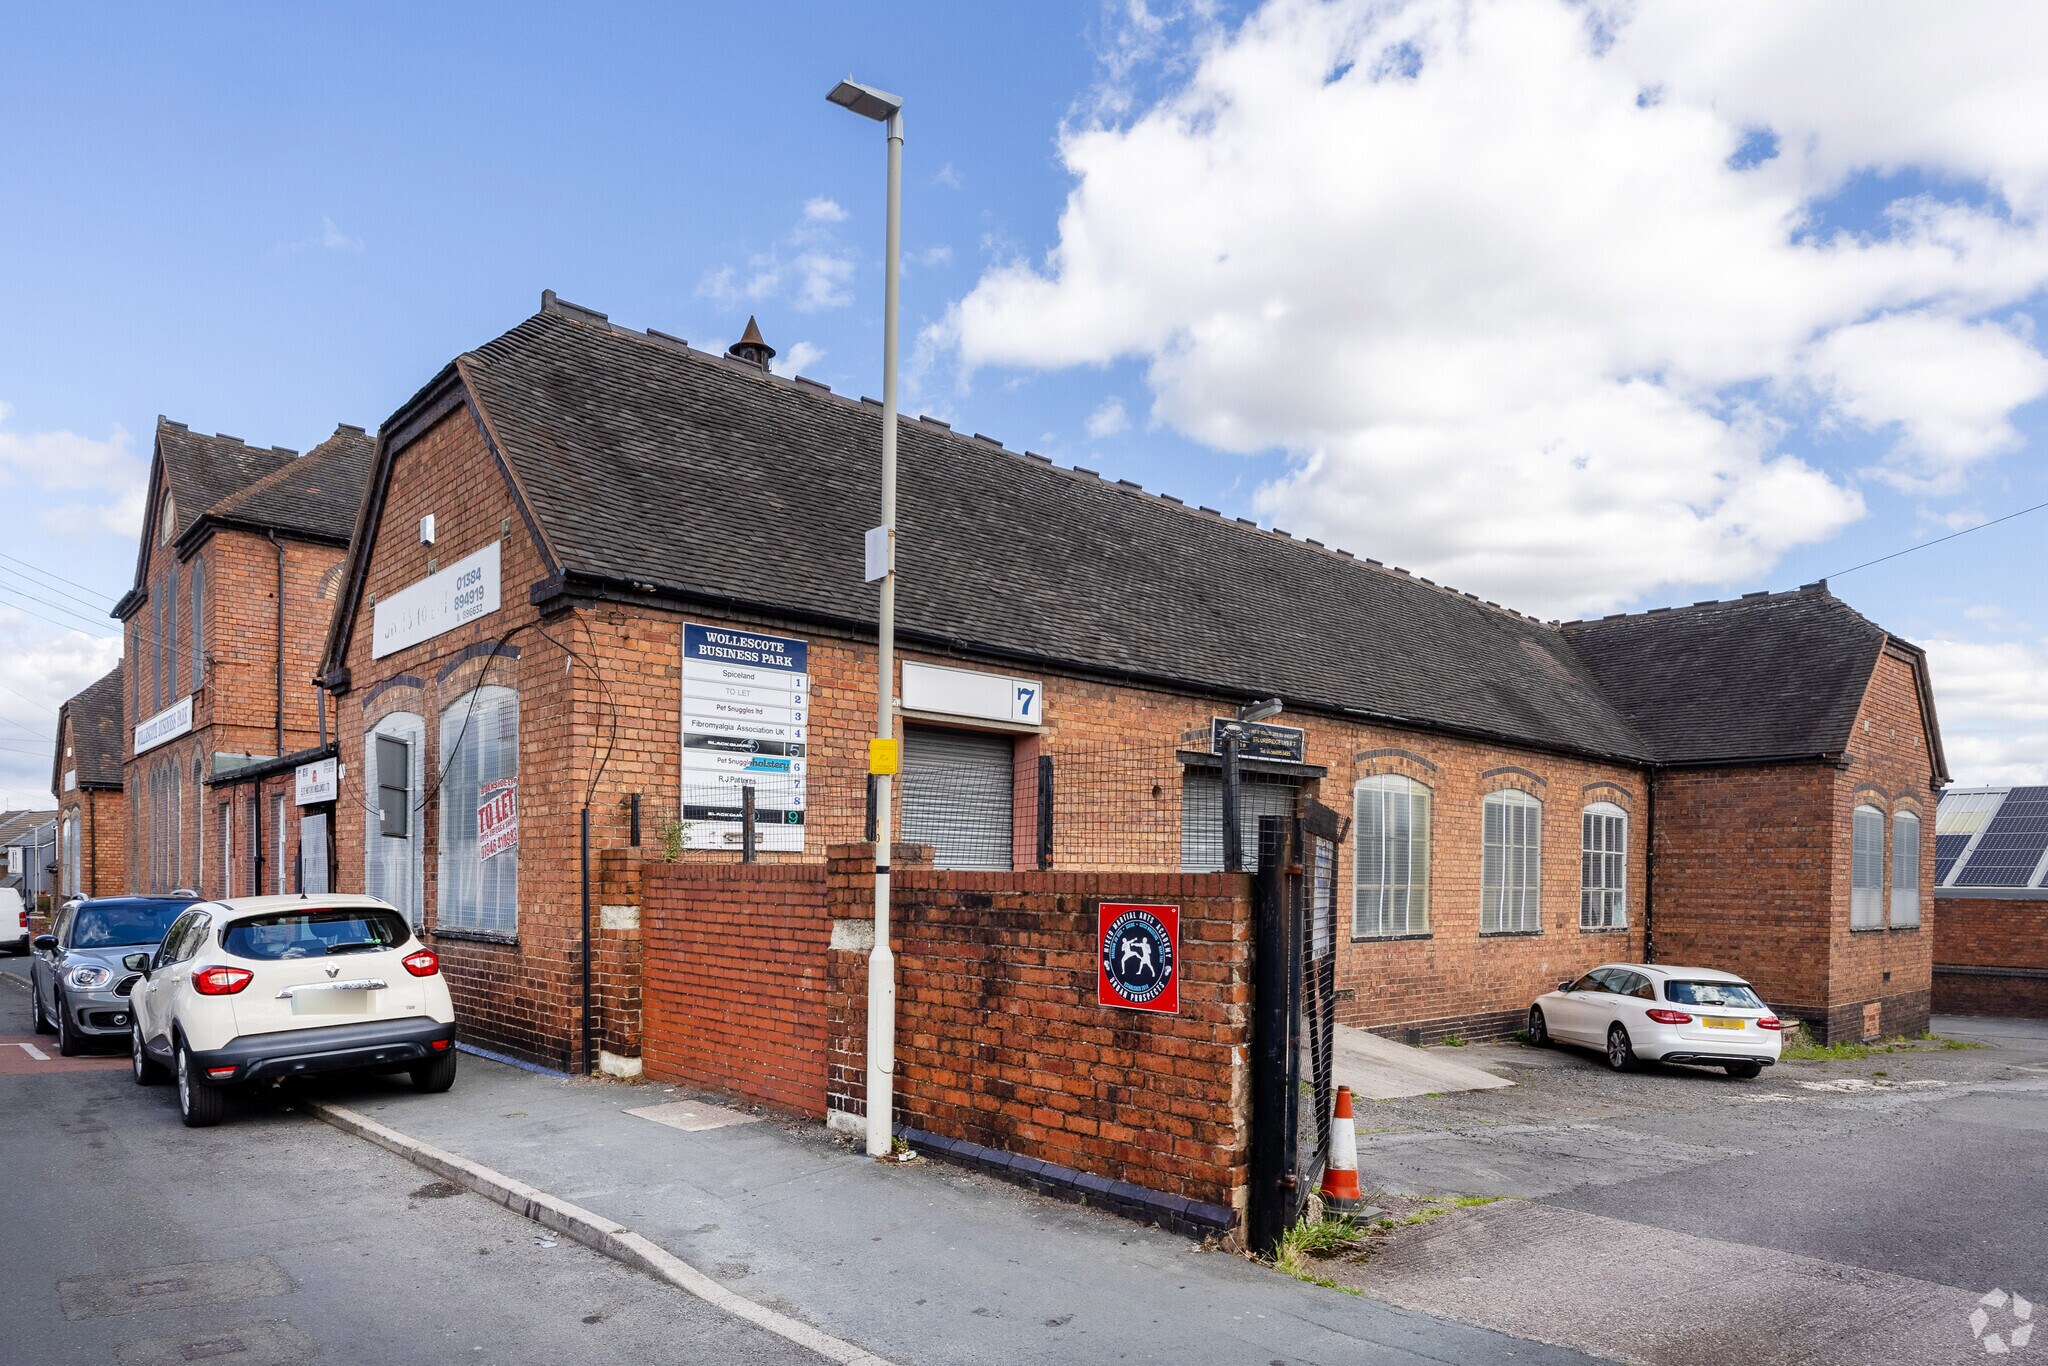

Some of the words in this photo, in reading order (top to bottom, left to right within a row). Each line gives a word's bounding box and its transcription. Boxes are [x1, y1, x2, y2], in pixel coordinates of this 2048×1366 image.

[456, 567, 482, 591] 01384
[454, 585, 485, 611] 894919
[462, 604, 483, 619] 896632
[706, 632, 785, 653] WOLLESCOTE
[698, 644, 759, 663] BUSINESS
[761, 653, 793, 667] PARK
[722, 670, 755, 680] Spiceland
[796, 679, 801, 687] 1
[726, 688, 736, 696] TO
[738, 689, 751, 697] LET
[794, 695, 801, 704] 2
[1017, 687, 1035, 715] 7
[716, 704, 727, 712] Pet
[728, 705, 754, 715] Snuggles
[794, 712, 801, 720] 3
[691, 720, 735, 731] Fibromyalgia
[736, 724, 774, 735] Association
[775, 727, 785, 736] UK
[794, 729, 801, 738] 4
[789, 744, 800, 757] 5
[750, 758, 790, 771] holstery
[793, 763, 801, 772] 6
[793, 780, 801, 788] 7
[793, 797, 801, 806] 8
[478, 803, 494, 834] TO
[495, 788, 515, 824] LET
[788, 811, 799, 824] 9
[1103, 930, 1114, 953] MIXED
[1112, 911, 1137, 930] MARTIAL
[1139, 911, 1155, 924] ARTS
[1155, 923, 1172, 958] ACADEMY
[1109, 976, 1128, 999] URBAN
[1130, 981, 1165, 1002] PROSPECTS
